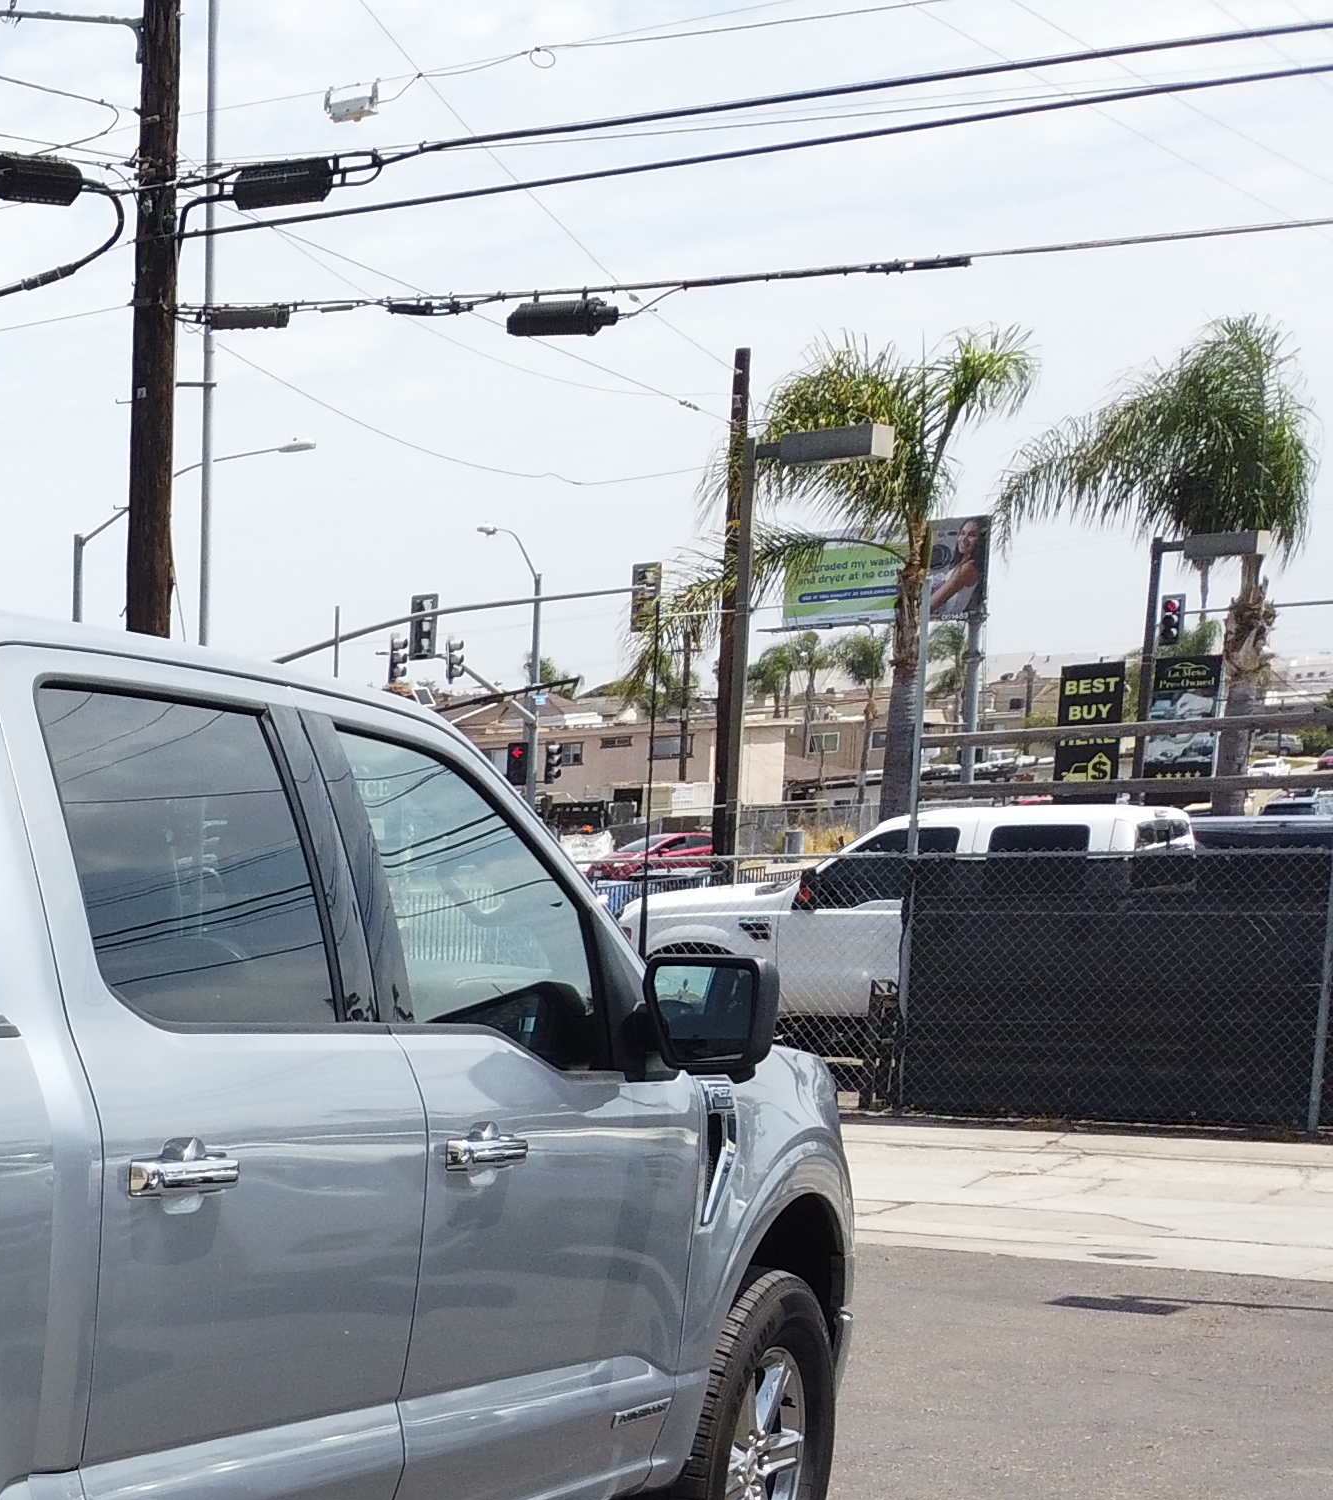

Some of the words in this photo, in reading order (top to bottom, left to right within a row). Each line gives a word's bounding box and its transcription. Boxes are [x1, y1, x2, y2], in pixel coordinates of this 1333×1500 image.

[818, 574, 845, 584] dryer
[849, 571, 858, 580] at
[862, 571, 874, 579] no
[1065, 677, 1120, 695] BEST
[1068, 703, 1113, 721] BUY
